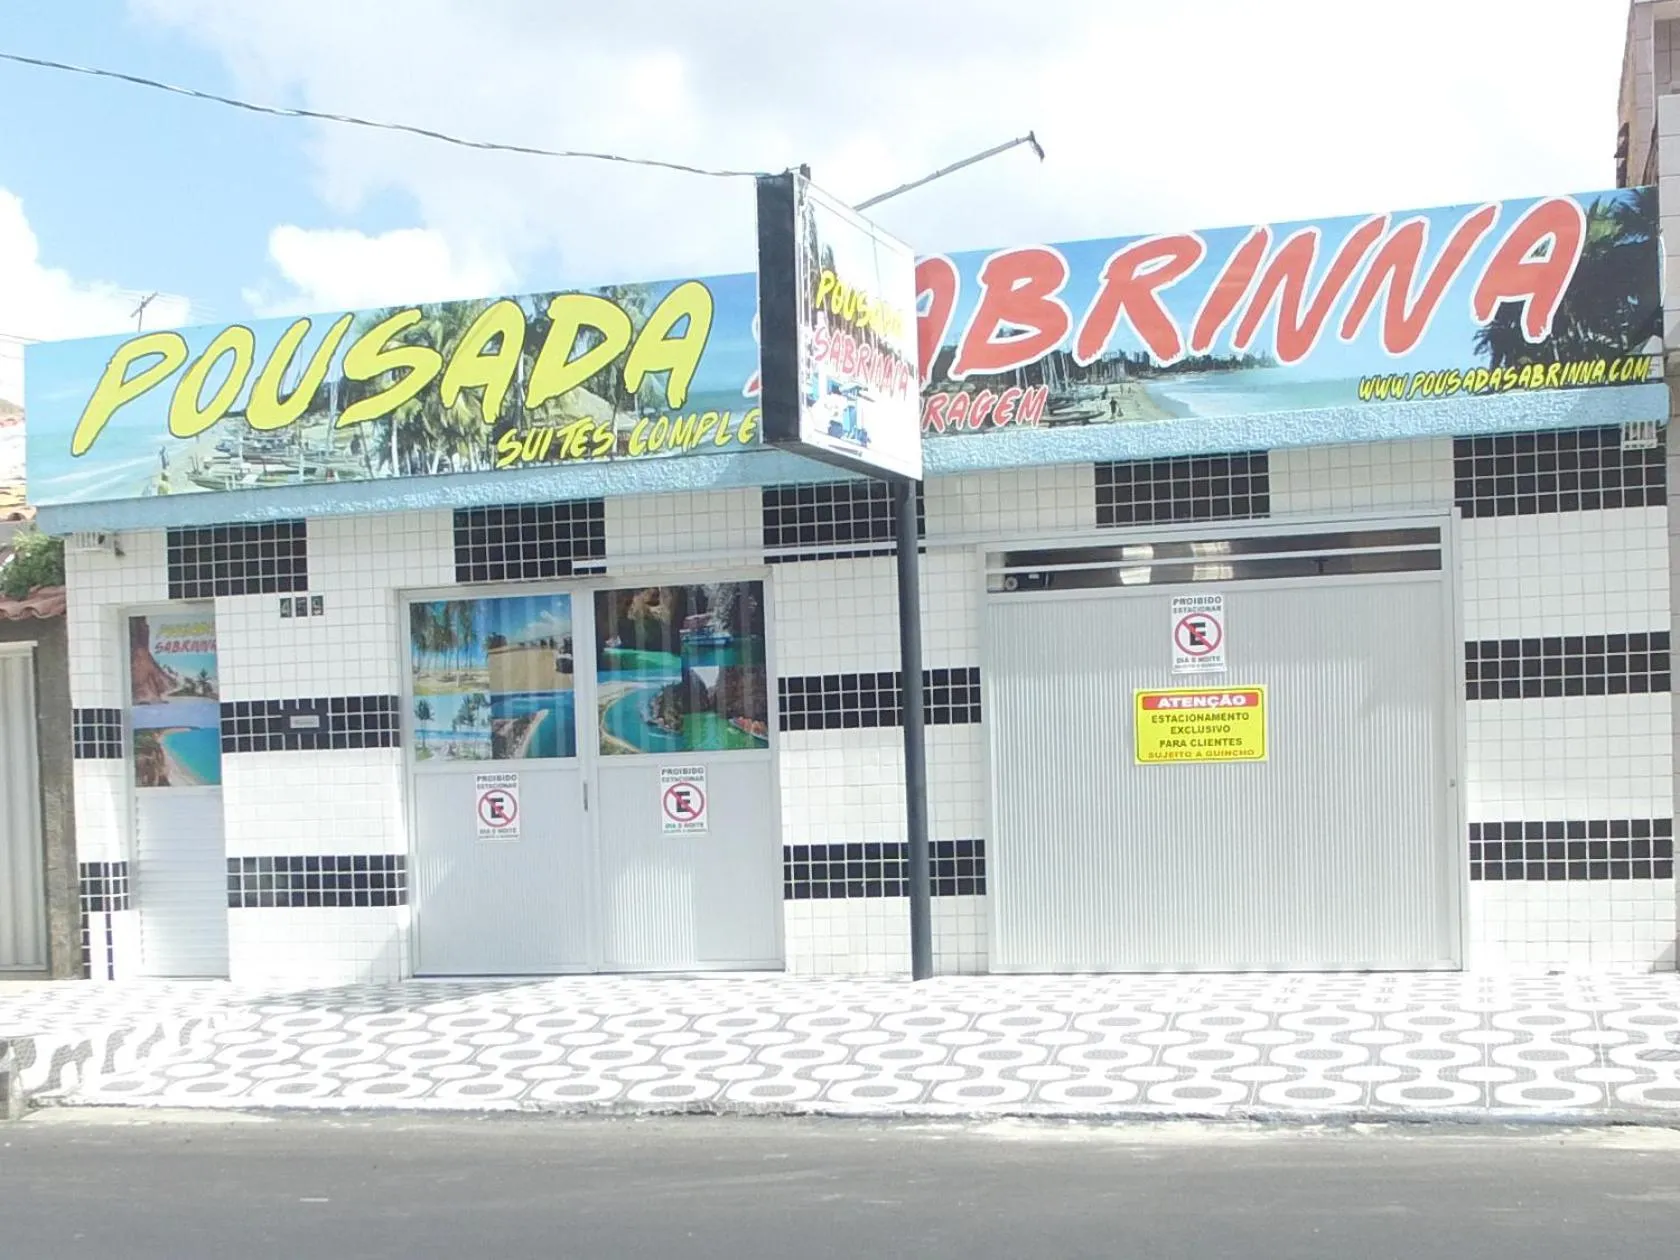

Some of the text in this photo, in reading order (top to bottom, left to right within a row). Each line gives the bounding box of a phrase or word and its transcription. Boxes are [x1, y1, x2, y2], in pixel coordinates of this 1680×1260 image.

[71, 194, 1588, 457] POUSADA ABRINNA
[496, 416, 617, 468] SUITES
[920, 384, 1049, 434] RAGEM
[1173, 596, 1222, 606] PROIBIDO
[1157, 694, 1246, 710] ATENÇÃO
[1151, 712, 1250, 723] ESTACIONAMENTO
[1170, 725, 1231, 735] EXCLUSIVO
[1159, 738, 1242, 748] PARA CLIENTES
[1148, 750, 1192, 759] SUJEITO
[1205, 749, 1255, 757] GUINCHO
[661, 767, 704, 775] PROIBIDO
